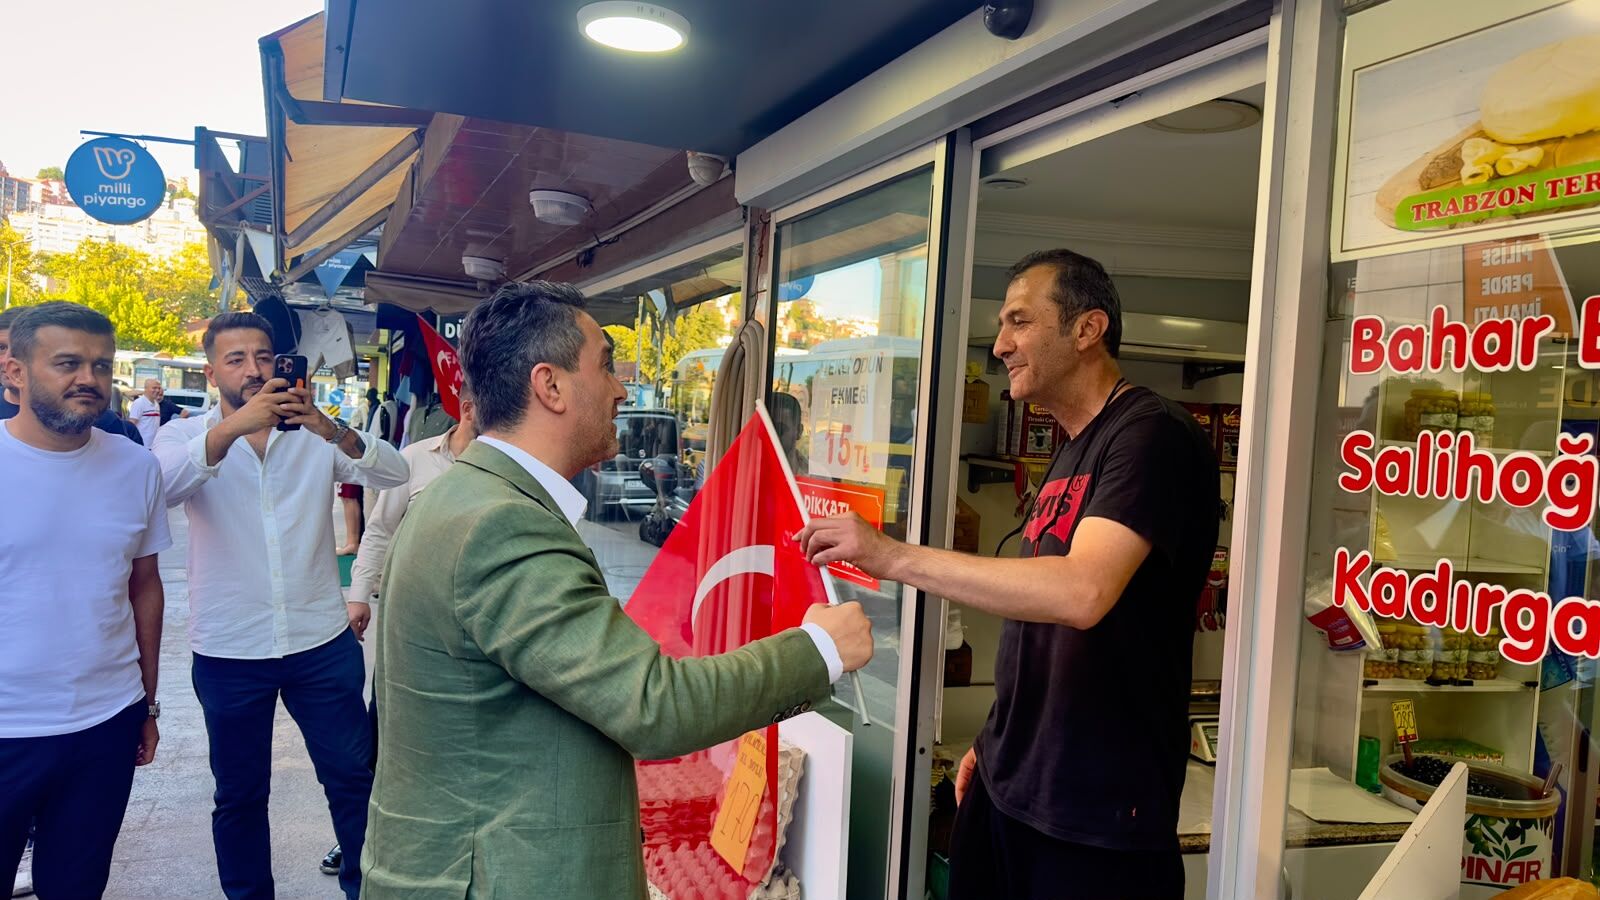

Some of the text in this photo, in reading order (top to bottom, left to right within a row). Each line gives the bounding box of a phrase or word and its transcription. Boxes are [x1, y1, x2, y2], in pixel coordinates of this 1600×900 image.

[83, 193, 146, 208] piyango
[98, 182, 131, 194] milli
[1411, 171, 1600, 222] TRABZON TER
[1349, 305, 1555, 375] Bahar
[1332, 547, 1600, 665] Kadırga
